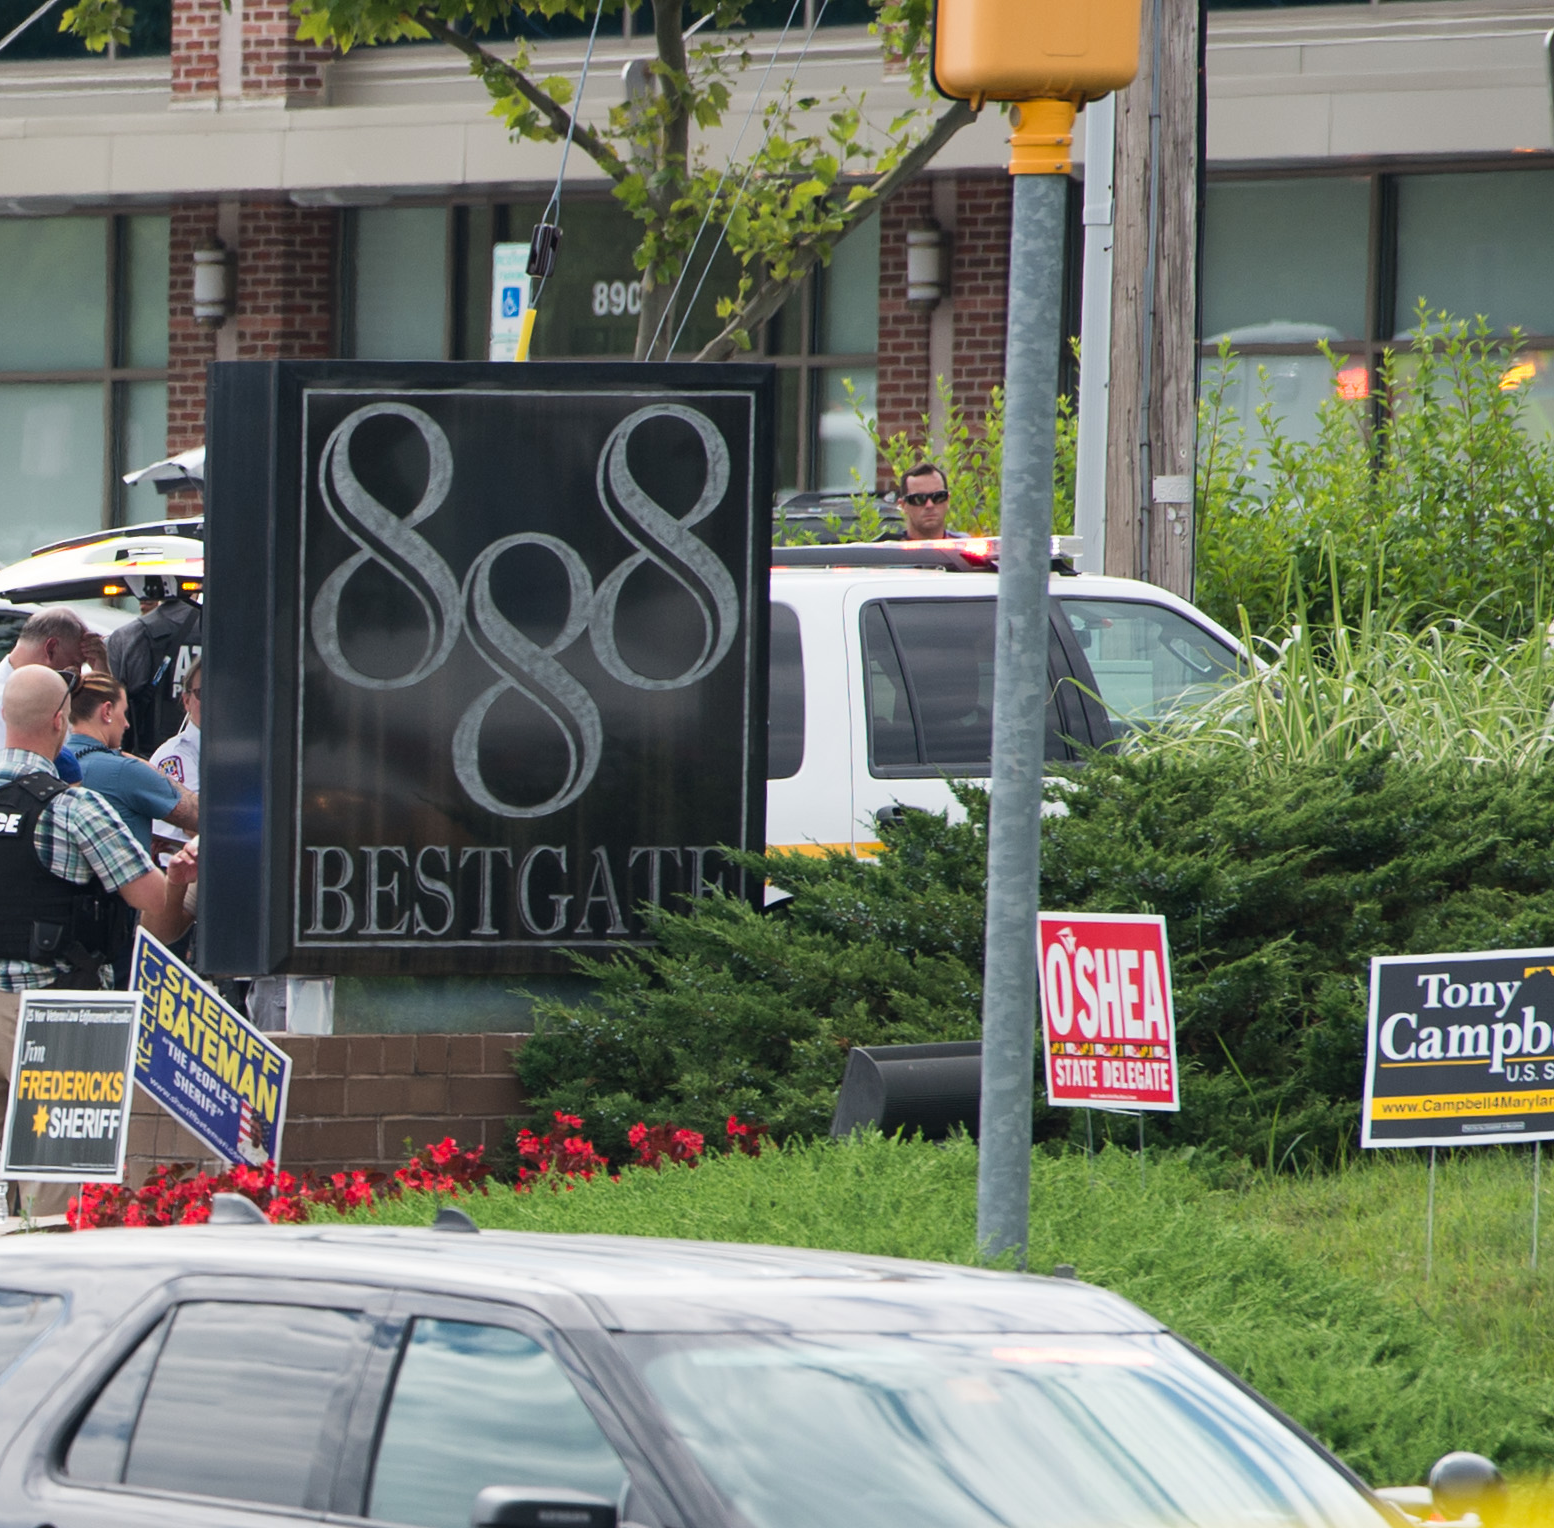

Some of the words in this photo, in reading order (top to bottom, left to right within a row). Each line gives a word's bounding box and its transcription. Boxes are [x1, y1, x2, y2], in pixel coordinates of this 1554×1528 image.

[304, 845, 725, 936] BESTGATE
[135, 941, 163, 1073] RE-ELECT
[163, 964, 280, 1076] SHERIFF
[1418, 974, 1522, 1018] Tony
[158, 986, 278, 1124] BATEMAN
[1380, 1006, 1554, 1073] Campb
[18, 1070, 124, 1102] FREDERICKS
[1055, 1059, 1097, 1087] STATE
[1102, 1061, 1170, 1091] DELEGATE
[1506, 1064, 1539, 1082] U.S.
[48, 1107, 121, 1139] SHERIFF
